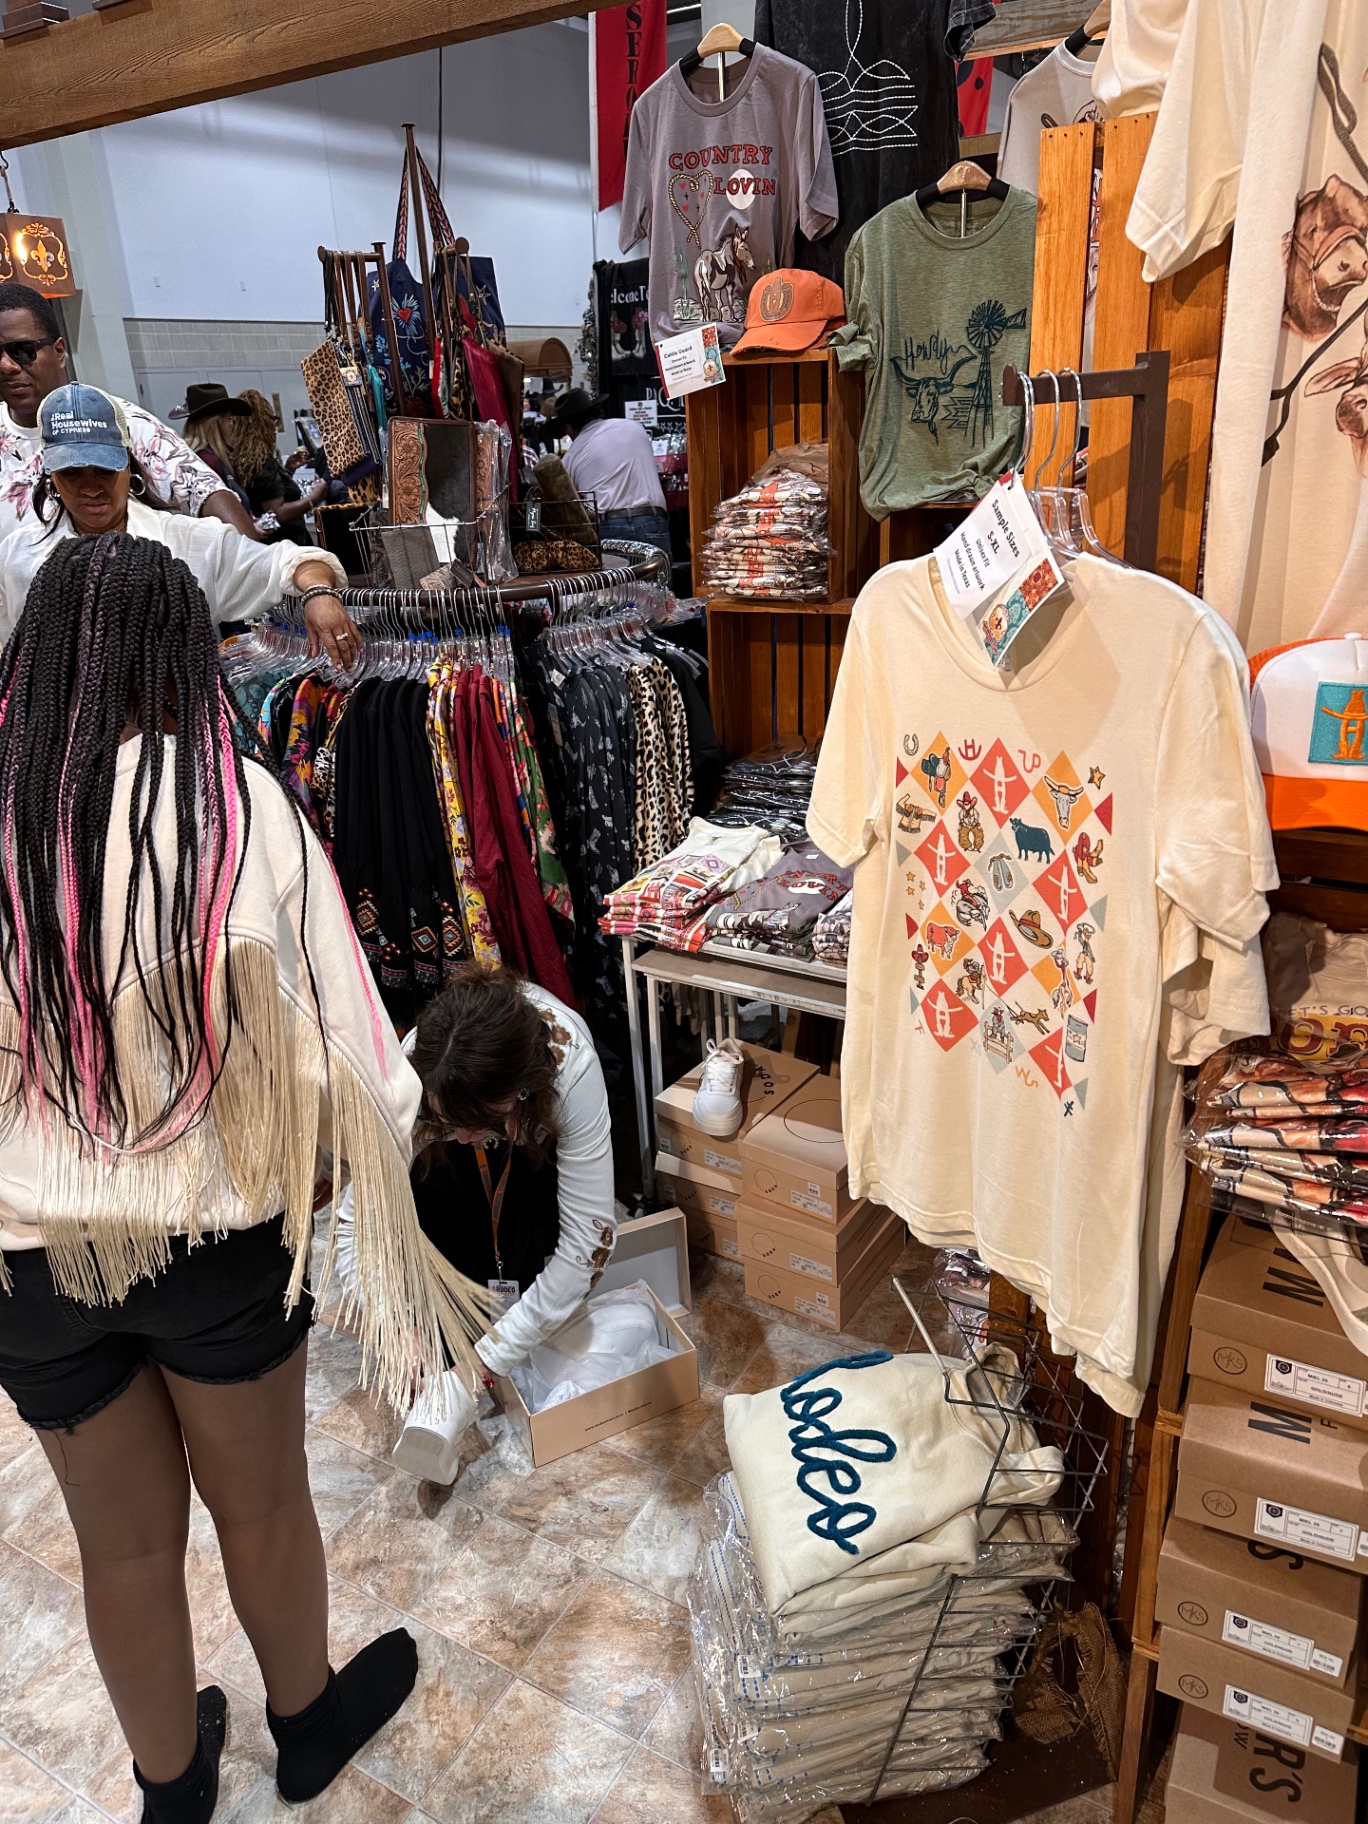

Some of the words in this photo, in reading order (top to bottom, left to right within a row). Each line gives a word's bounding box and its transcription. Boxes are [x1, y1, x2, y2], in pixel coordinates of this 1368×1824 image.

[669, 144, 773, 171] COUNTRY
[714, 177, 776, 195] LOVIN
[55, 411, 74, 420] Real
[991, 499, 1009, 535] Sample
[1006, 531, 1020, 558] Sizes
[975, 538, 987, 561] Unisex
[987, 530, 1001, 555] S-XL
[954, 549, 964, 566] Made
[962, 570, 971, 588] Texas
[960, 531, 970, 549] Hand
[965, 547, 977, 567] drawn
[973, 565, 985, 591] artwork
[754, 1064, 775, 1096] SODA
[1216, 1351, 1244, 1370] MKS
[1206, 1494, 1233, 1513] MKS
[1181, 1605, 1204, 1623] MKS
[1181, 1679, 1205, 1696] MKS
